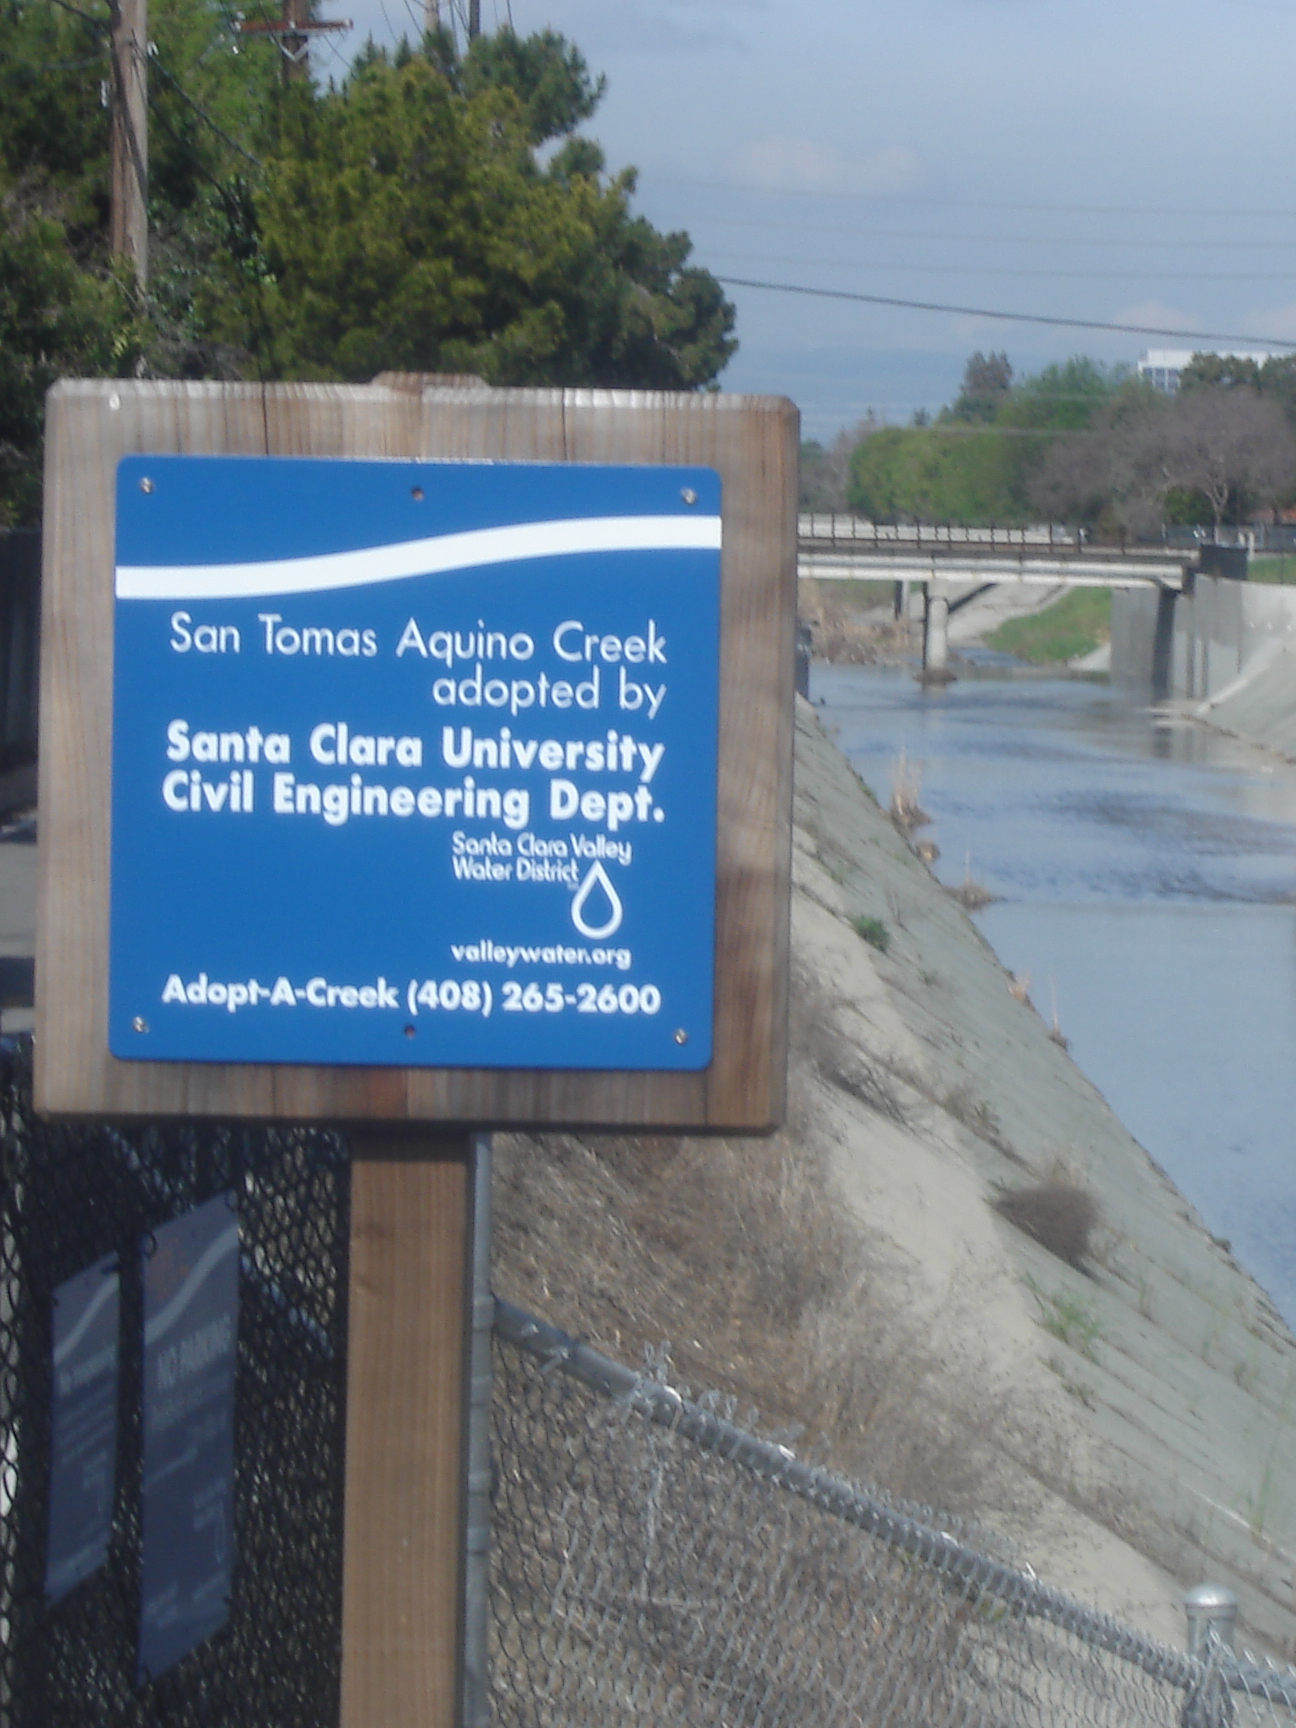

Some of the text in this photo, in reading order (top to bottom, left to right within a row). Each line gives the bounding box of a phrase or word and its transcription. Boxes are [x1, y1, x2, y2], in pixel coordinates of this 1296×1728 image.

[171, 611, 666, 666] San Tomas Aquino Creek
[433, 664, 666, 718] adopted by
[167, 720, 665, 782] Santa Clara University
[162, 770, 664, 831] Civil Engineering Dept.
[452, 830, 632, 867] Santa Clara Valley
[452, 856, 579, 883] Water District
[451, 940, 631, 970] valleywater.org
[162, 973, 661, 1017] Adopt-A-Creek (408) 265-2600
